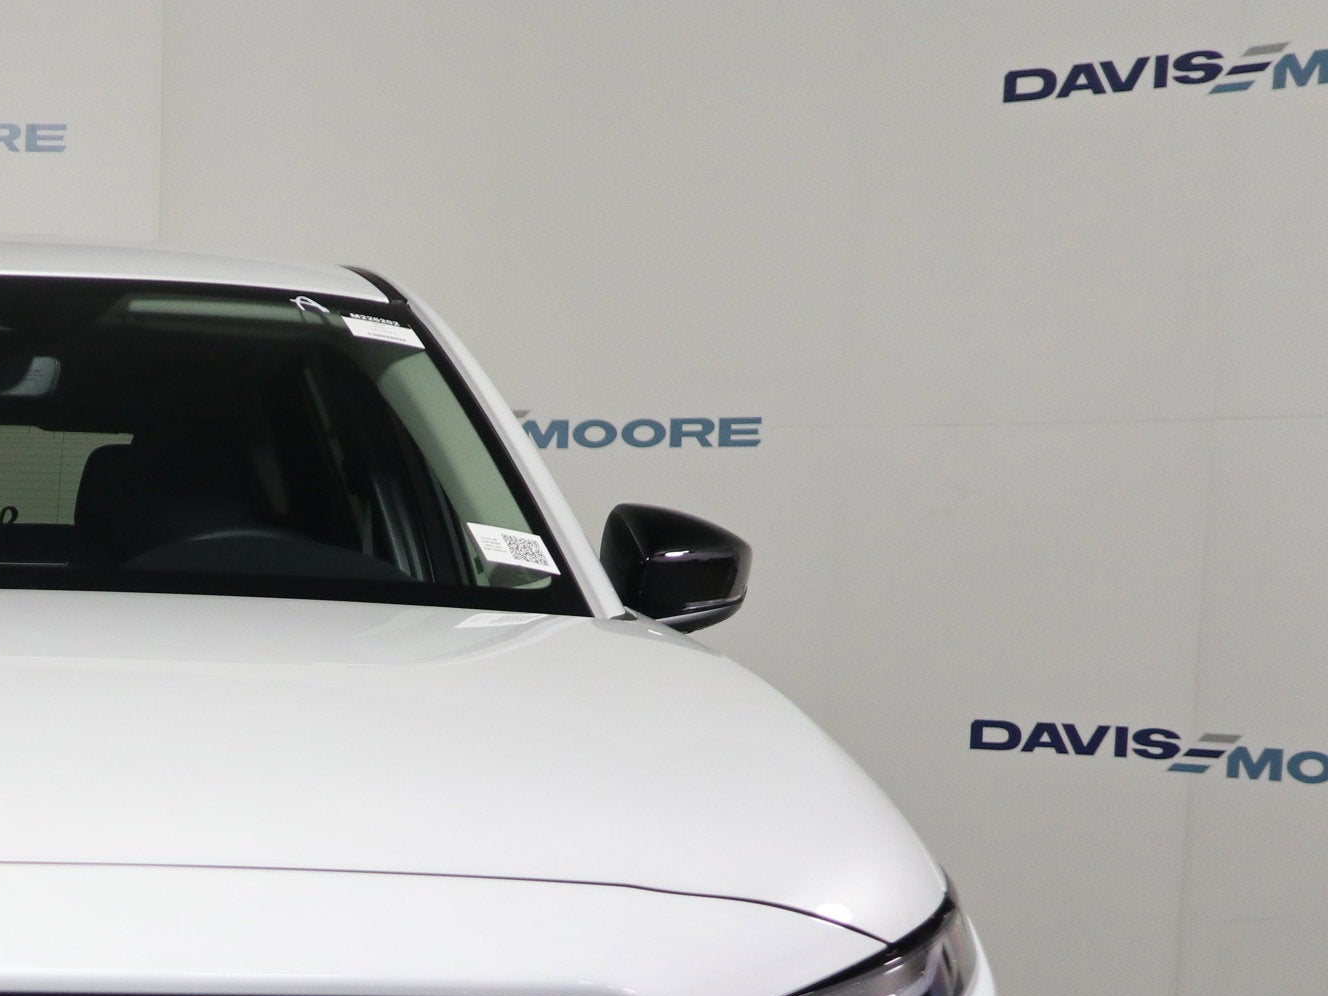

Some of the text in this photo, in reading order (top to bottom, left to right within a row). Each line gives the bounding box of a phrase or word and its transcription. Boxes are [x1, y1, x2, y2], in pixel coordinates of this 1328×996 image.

[1003, 50, 1224, 102] DAVIS
[522, 416, 762, 449] MOORE
[970, 719, 1181, 760] DAVIS
